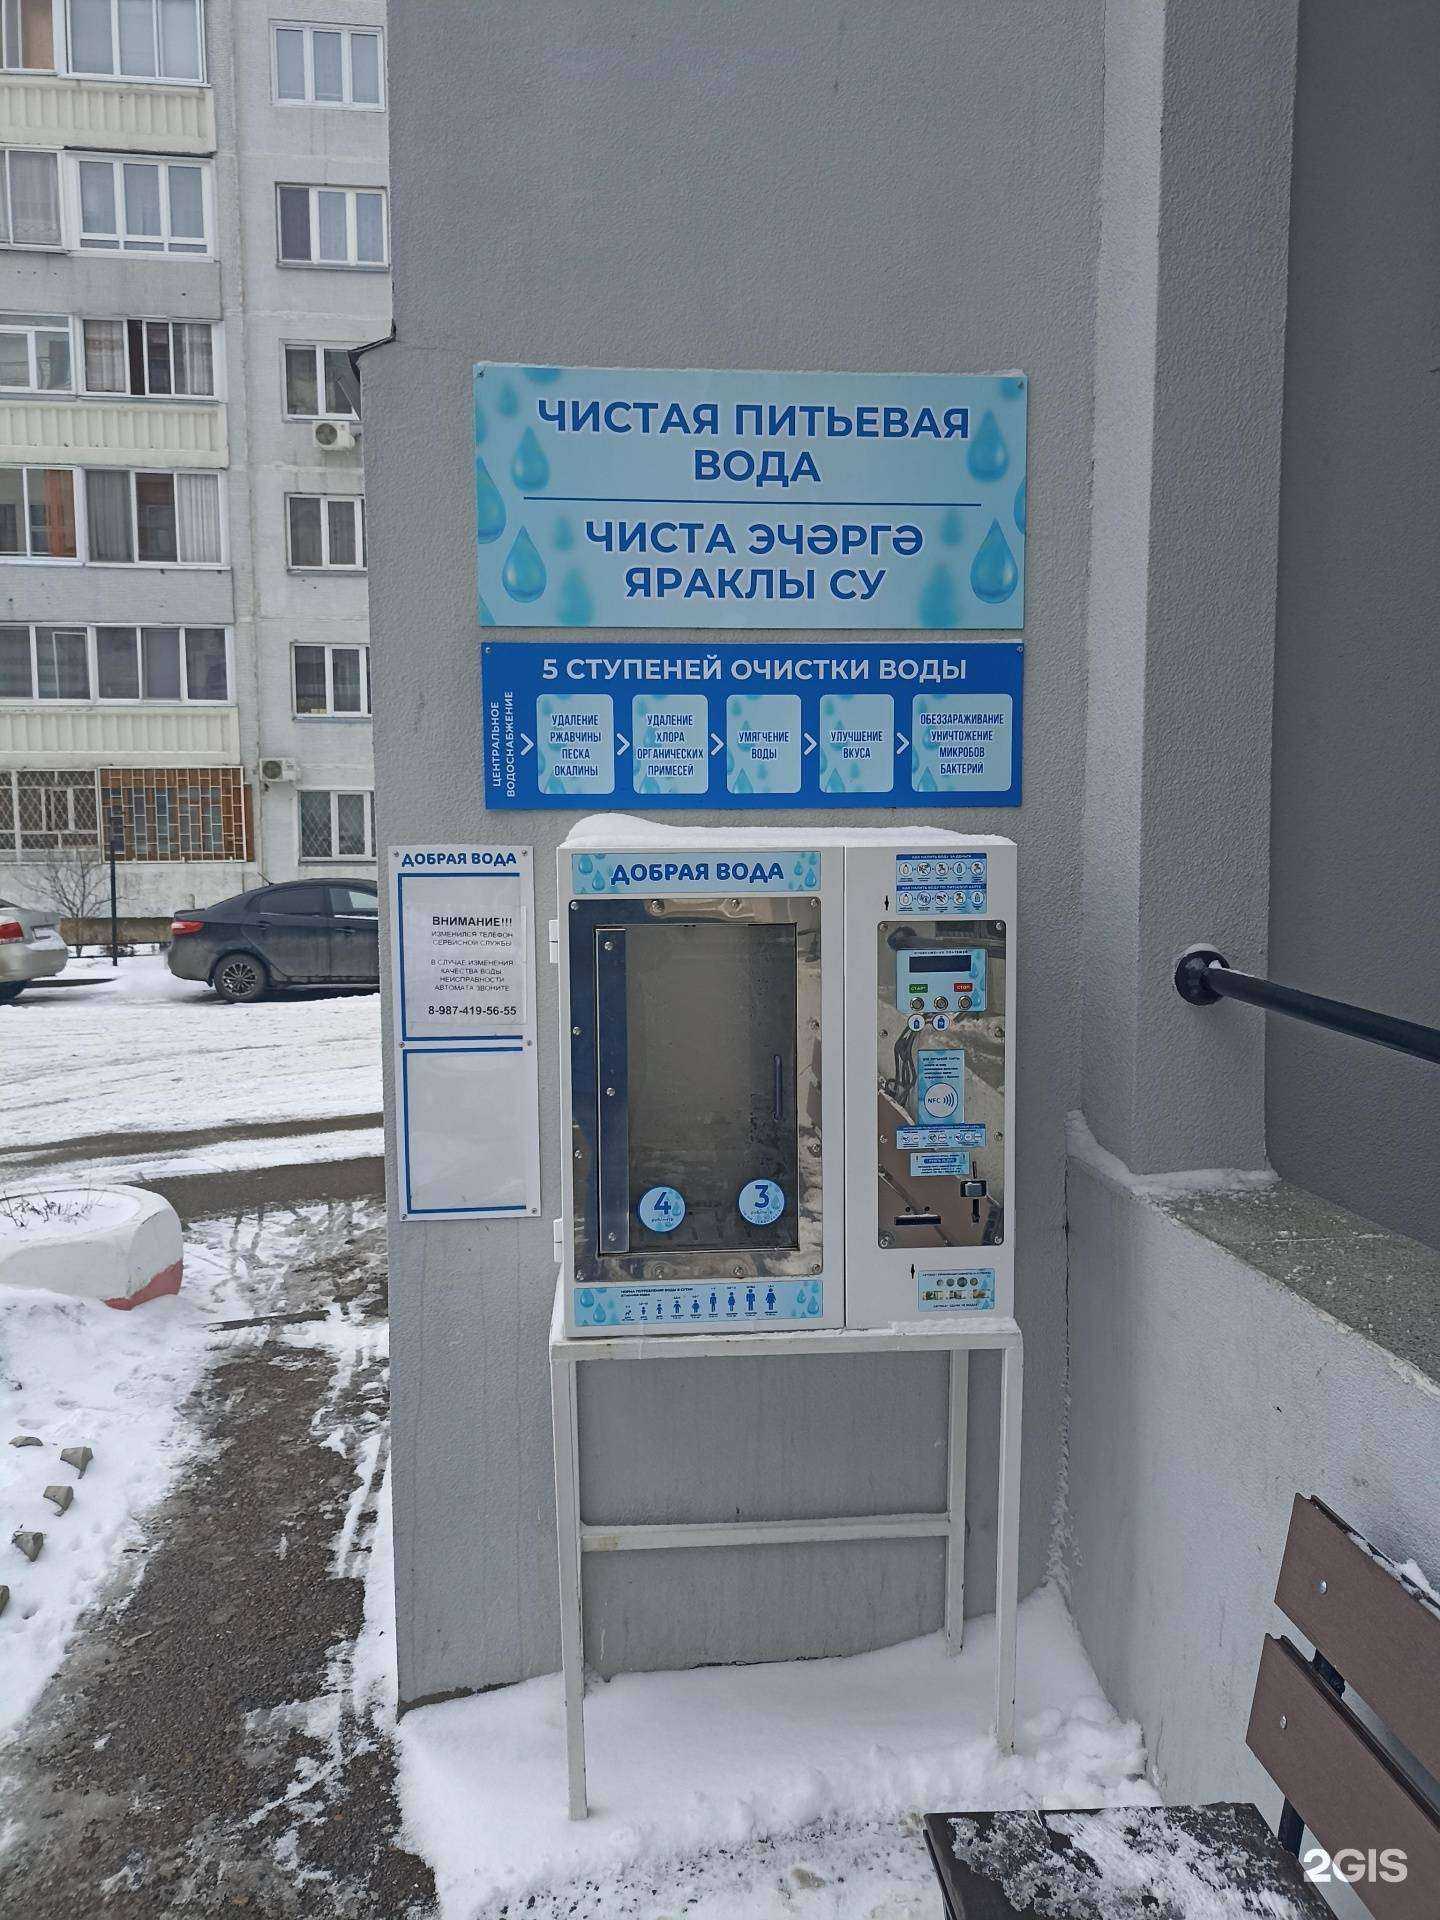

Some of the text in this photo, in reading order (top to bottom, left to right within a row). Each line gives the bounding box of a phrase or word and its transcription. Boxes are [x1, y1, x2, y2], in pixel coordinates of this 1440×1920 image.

[538, 399, 970, 439] ЧИСТАЯ ПИТЬЕВАЯ
[693, 449, 821, 488] ВОДА
[585, 520, 924, 557] ЧИСТА ЭЧӘРГӘ
[625, 567, 886, 600] ЯРАКЛЫ СУ
[542, 654, 967, 684] 5 СТУПЕНЕЙ ОЧИСТКИ ВОДЫ
[552, 714, 599, 727] УДАЛЕНИЕ
[647, 714, 694, 727] УДАЛЕНИЕ
[920, 713, 1004, 725] ОБЕЗЗАРАЖИВАНИЕ
[550, 731, 602, 743] РЖАВЧИНЫ
[656, 731, 685, 743] ХЛОРА
[738, 731, 790, 743] УМЯГЧЕНИЕ
[830, 730, 884, 743] УЛУЧШЕНИЕ
[931, 730, 994, 741] УНИЧТОЖЕНИЕ
[490, 701, 502, 787] ЦЕНТРАЛЬНОЕ
[504, 691, 516, 797] ВОДОСНАБЖЕНИЕ
[562, 748, 591, 760] ПЕСКА
[637, 748, 704, 760] ОРГАНИЧЕСКИХ
[751, 748, 778, 760] ВОДЫ
[843, 747, 872, 759] ВКУСА
[939, 746, 985, 758] МИКРОБОВ
[554, 765, 599, 776] ОКАЛИНЫ
[647, 764, 694, 777] ПРИМЕСЕЙ
[940, 761, 984, 774] БАКТЕРИЙ
[401, 852, 517, 867] ДОБРАЯ ВОДА
[610, 862, 785, 886] ДОБРАЯ ВОДА
[432, 916, 513, 927] ВНИМАНИЕ!!!
[480, 931, 514, 939] ТЕЛЕФОН
[468, 959, 514, 967] ИЗМЕНЕНИЯ
[428, 1005, 517, 1016] 8-987-419-56-55
[653, 1191, 672, 1215] 4
[754, 1184, 770, 1209] 3
